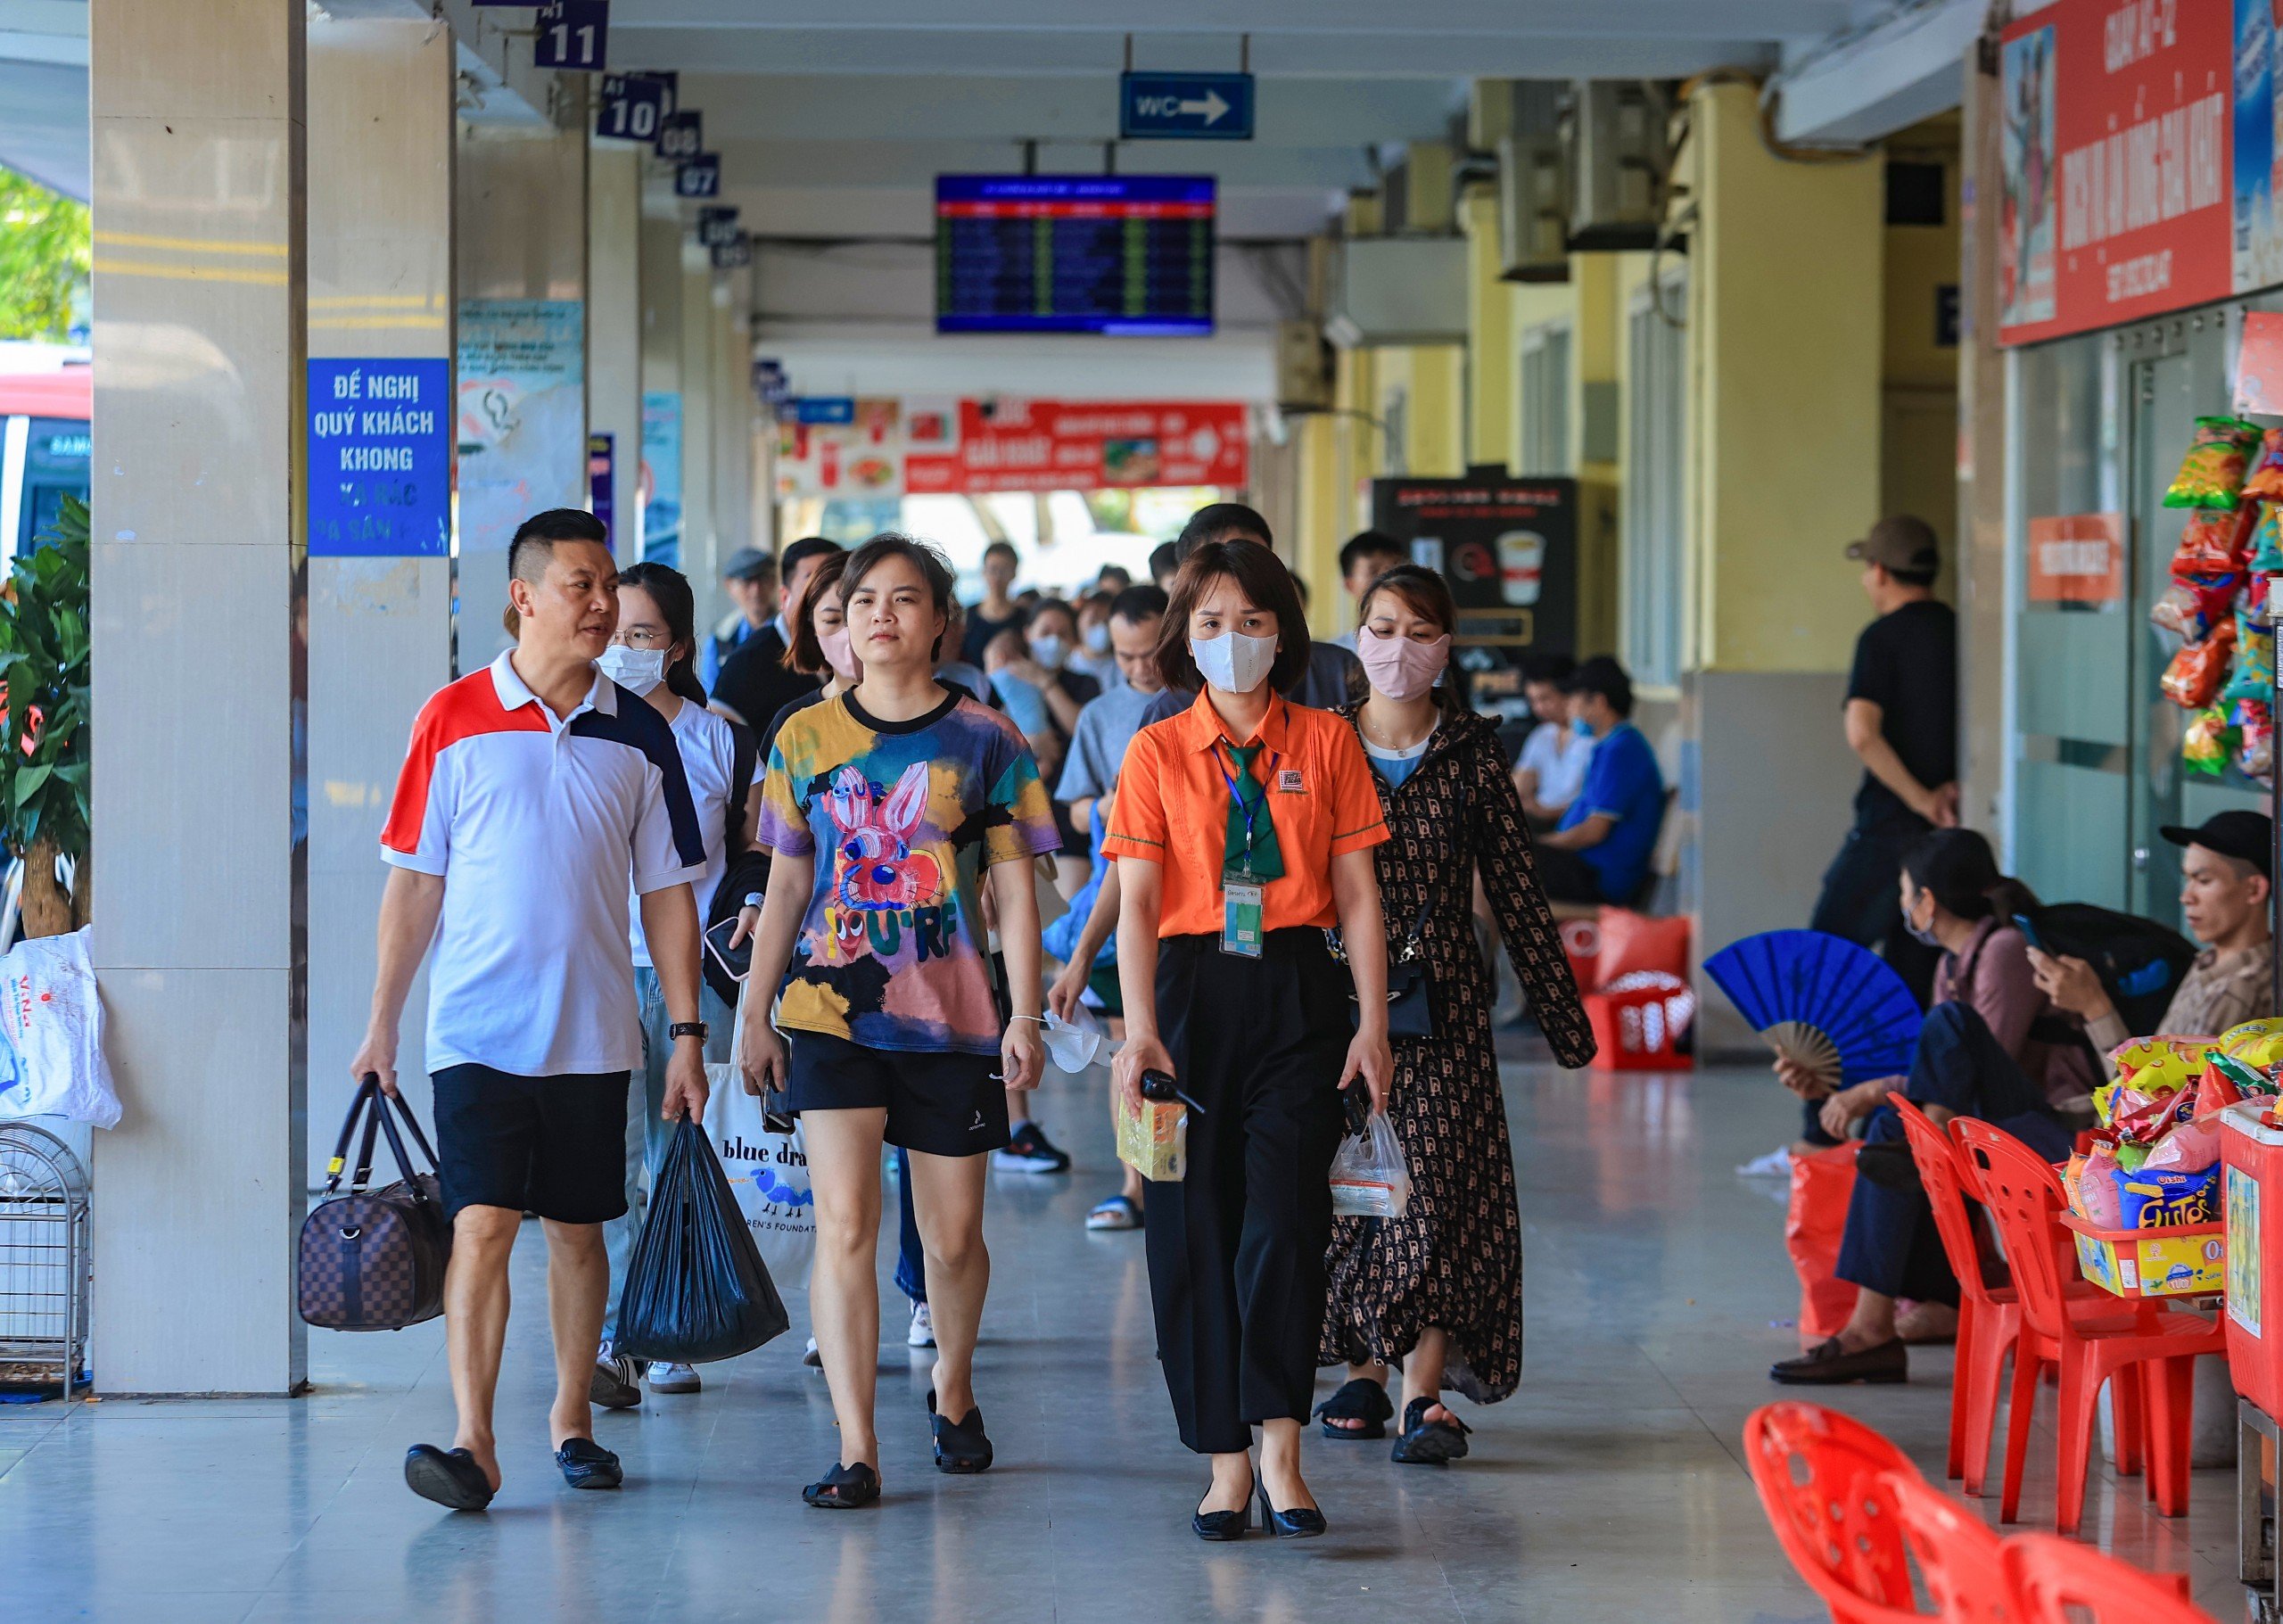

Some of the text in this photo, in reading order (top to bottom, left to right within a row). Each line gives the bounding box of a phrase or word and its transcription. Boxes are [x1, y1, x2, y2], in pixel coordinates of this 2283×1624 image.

[549, 23, 596, 64] 11
[613, 100, 655, 137] 10
[1136, 95, 1180, 118] WC
[368, 374, 419, 404] NGHỊ
[314, 404, 434, 439] QUÝ KHÁCH
[722, 1136, 810, 1168] blue dra
[2157, 1175, 2187, 1185] Oishi
[774, 1223, 817, 1233] FOUNDAT
